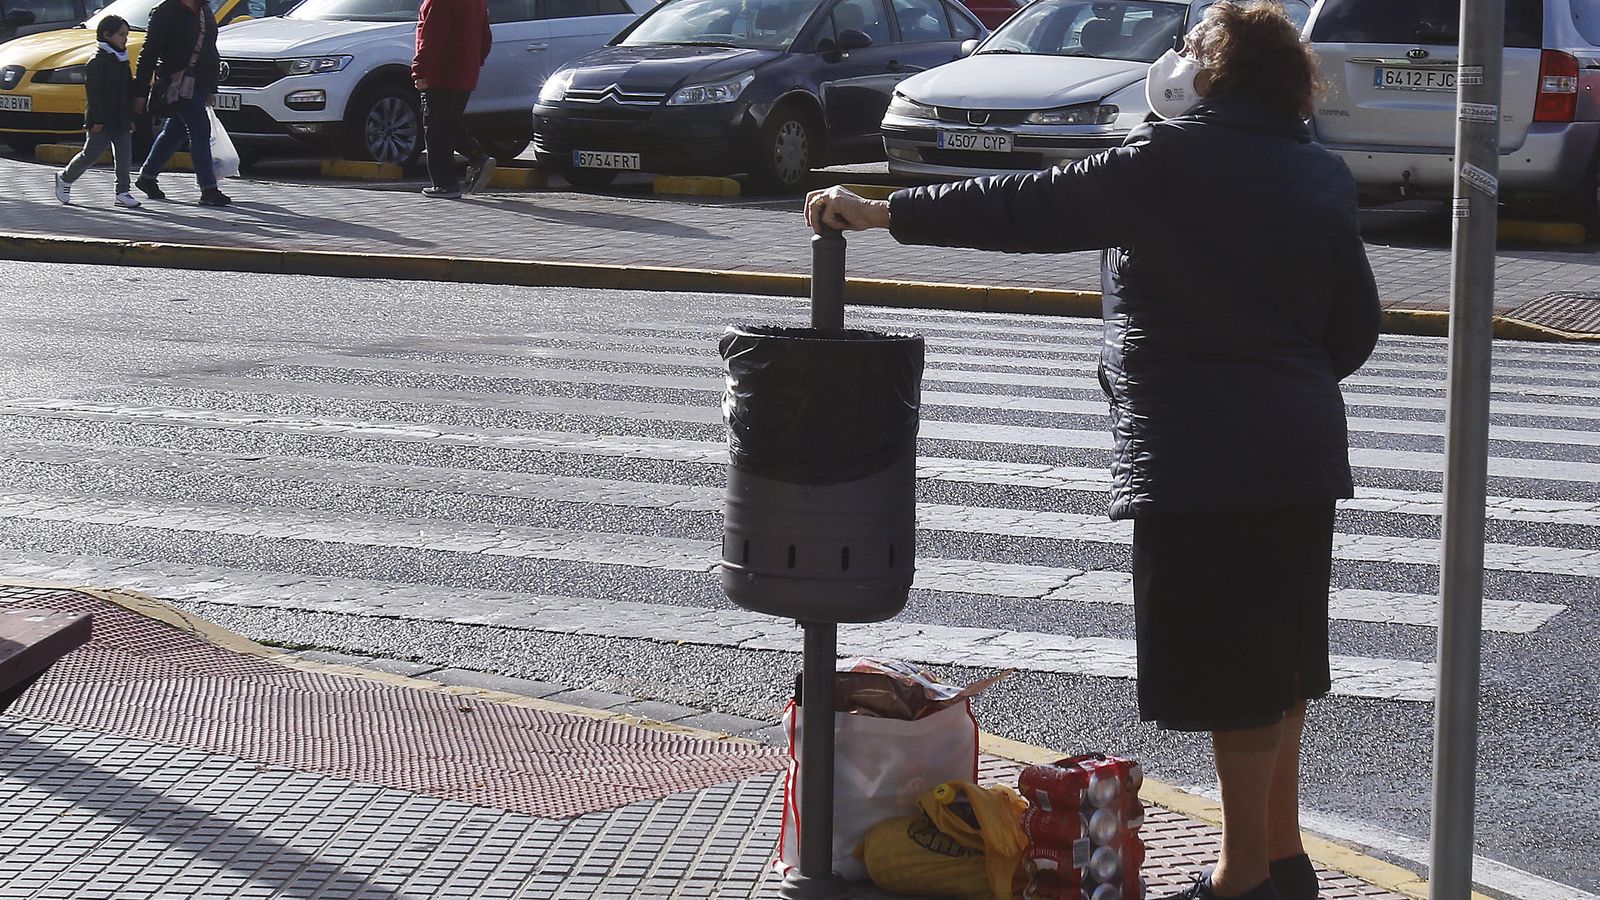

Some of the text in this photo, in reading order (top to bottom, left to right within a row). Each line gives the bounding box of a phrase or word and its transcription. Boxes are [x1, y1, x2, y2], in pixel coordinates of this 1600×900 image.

[1385, 70, 1423, 86] 6412
[1427, 72, 1455, 87] FJC
[947, 134, 1007, 150] 4507 CYP
[579, 152, 638, 169] 6754 FRT
